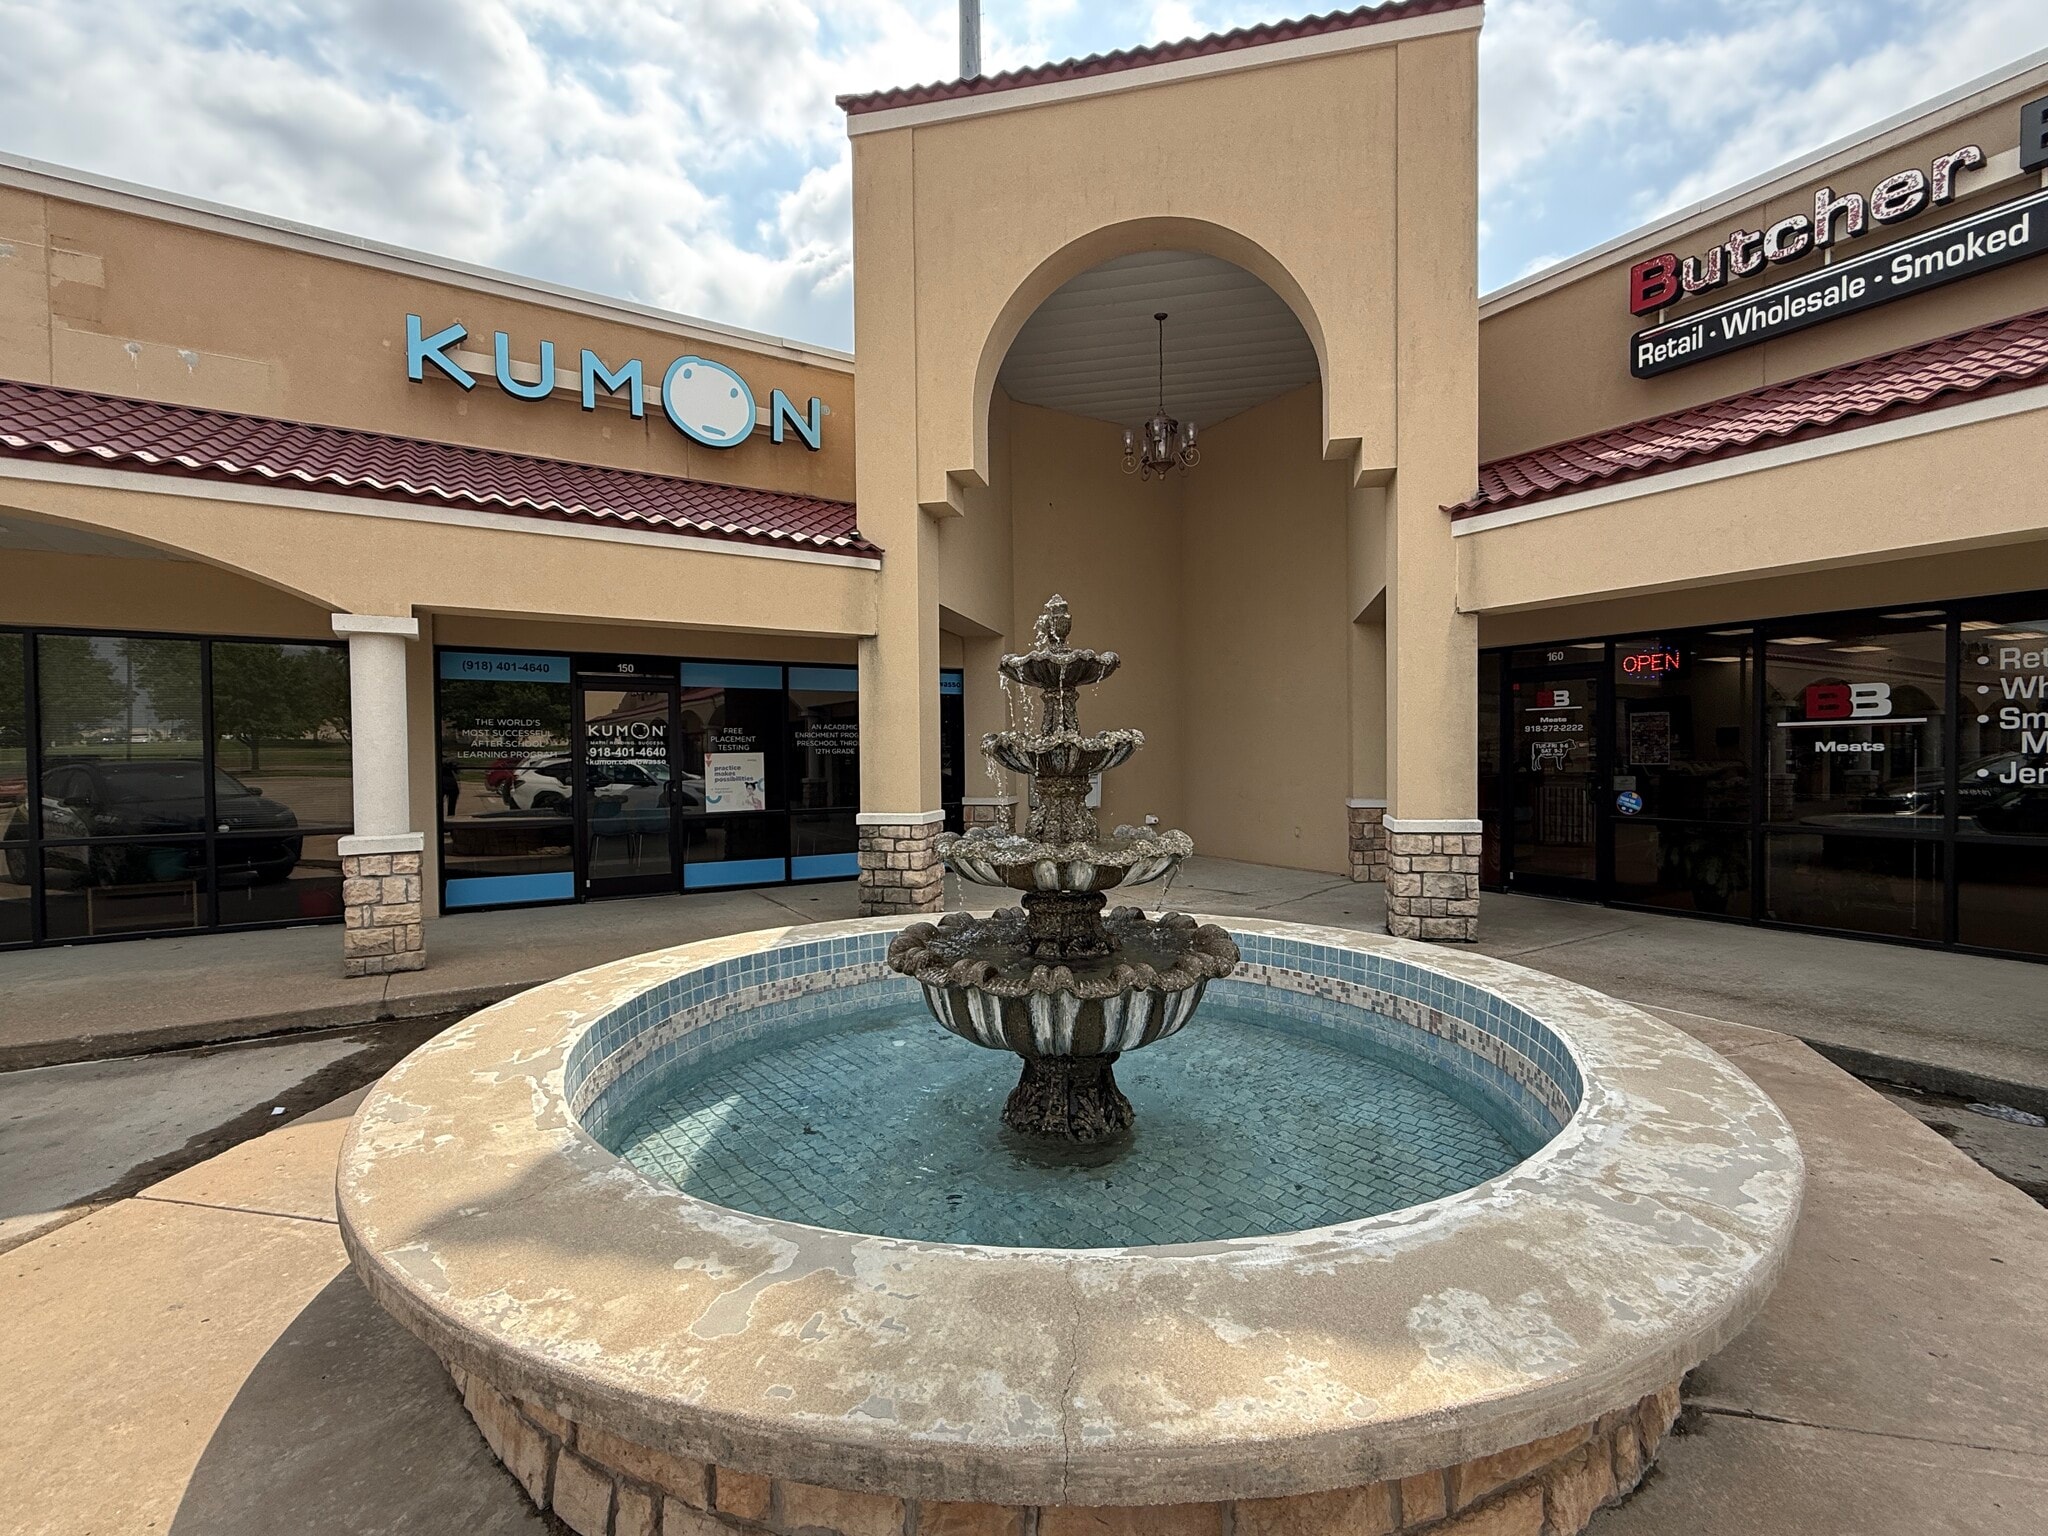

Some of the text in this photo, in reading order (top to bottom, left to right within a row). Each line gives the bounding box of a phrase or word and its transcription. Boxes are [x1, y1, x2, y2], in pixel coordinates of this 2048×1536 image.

[1630, 144, 1985, 316] Butcher
[1637, 211, 2031, 369] Retail Wholesale Smoked
[405, 313, 822, 452] KUMON
[1547, 652, 1564, 662] 160
[462, 660, 550, 674] (918) 401-4640
[1622, 652, 1680, 673] OPEN
[617, 663, 635, 674] 150
[475, 718, 541, 727] THE WORLD'S
[823, 723, 858, 731] ACADEMIC
[588, 722, 665, 740] KUMON
[723, 727, 743, 735] FREE
[1524, 724, 1584, 733] 918-272-2222
[462, 729, 554, 738] MOST SUCCESSFUL
[794, 731, 839, 739] ENRICHMENT
[710, 735, 756, 743] PLACEMENT
[470, 740, 547, 748] AFTER-SCHOOL
[1815, 741, 1886, 752] Meats
[457, 750, 558, 759] LEARNING PROGRAM
[589, 747, 667, 758] 918-401-4640
[714, 764, 742, 772] practice
